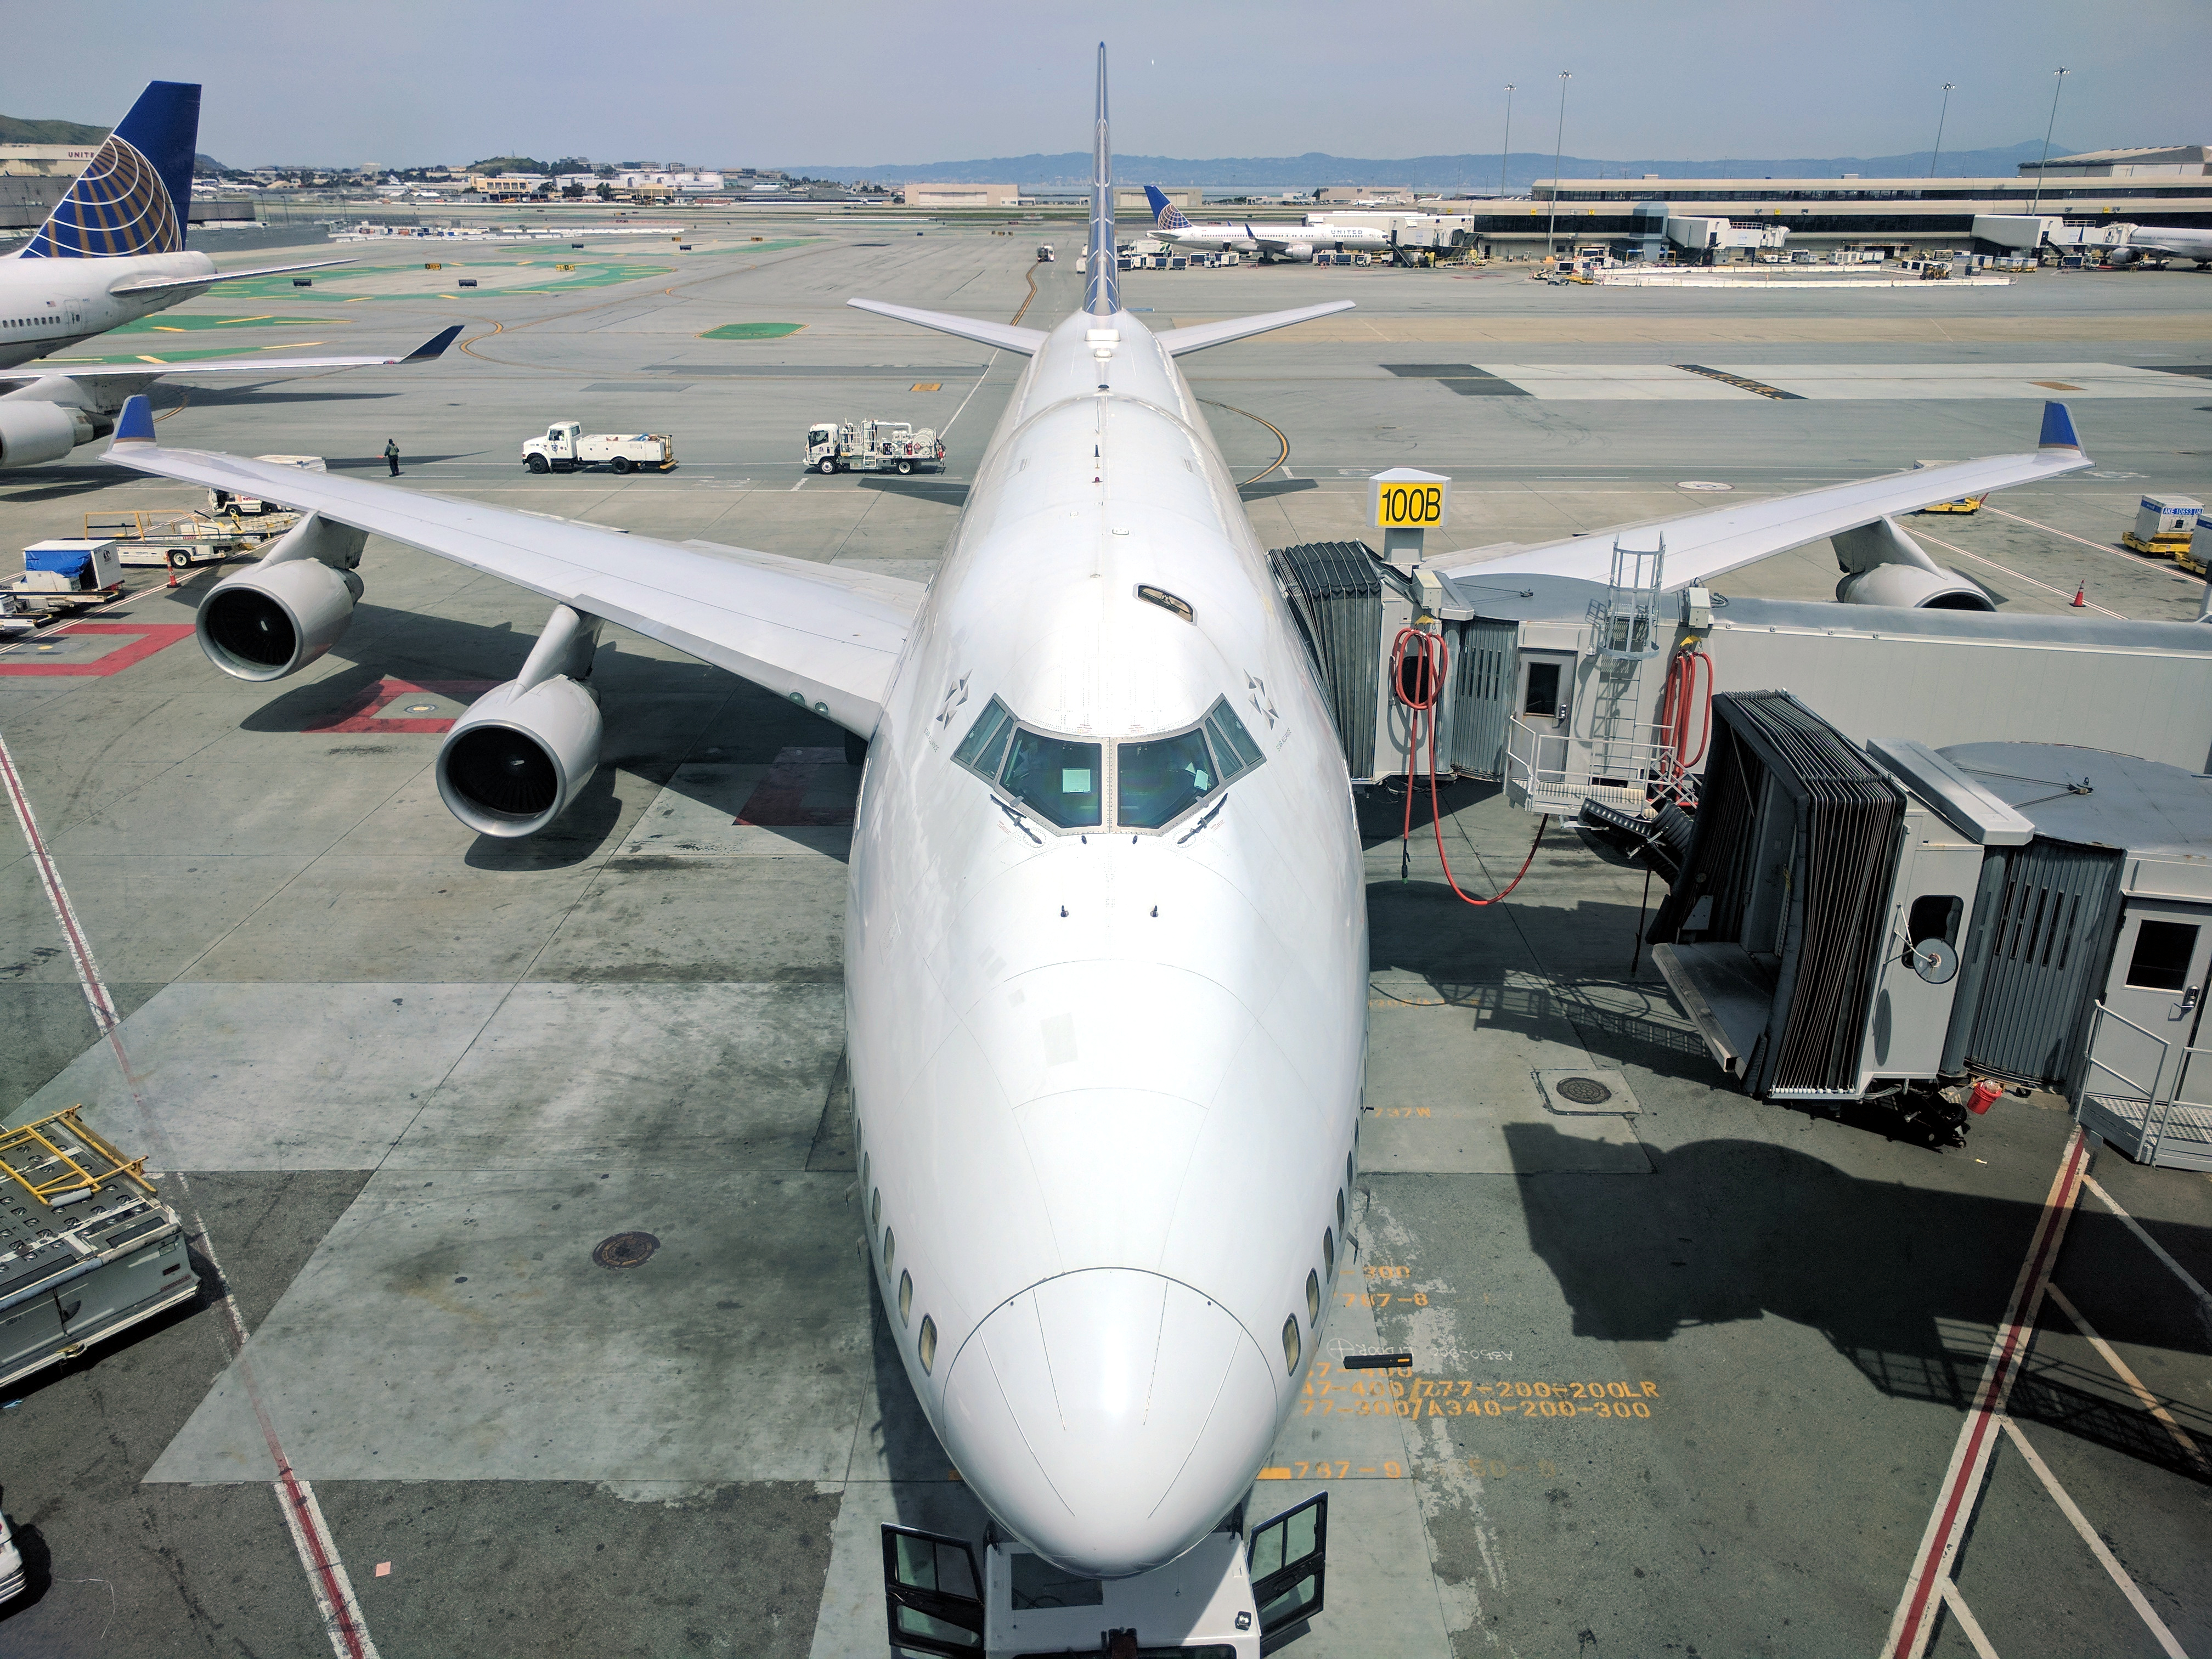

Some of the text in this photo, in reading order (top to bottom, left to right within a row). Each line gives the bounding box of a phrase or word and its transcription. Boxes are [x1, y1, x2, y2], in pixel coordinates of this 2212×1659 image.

[1381, 488, 1441, 522] 100B
[1374, 1107, 1431, 1118] 737W
[1308, 1362, 1413, 1378] 7-400
[1294, 1461, 1402, 1480] 787-9
